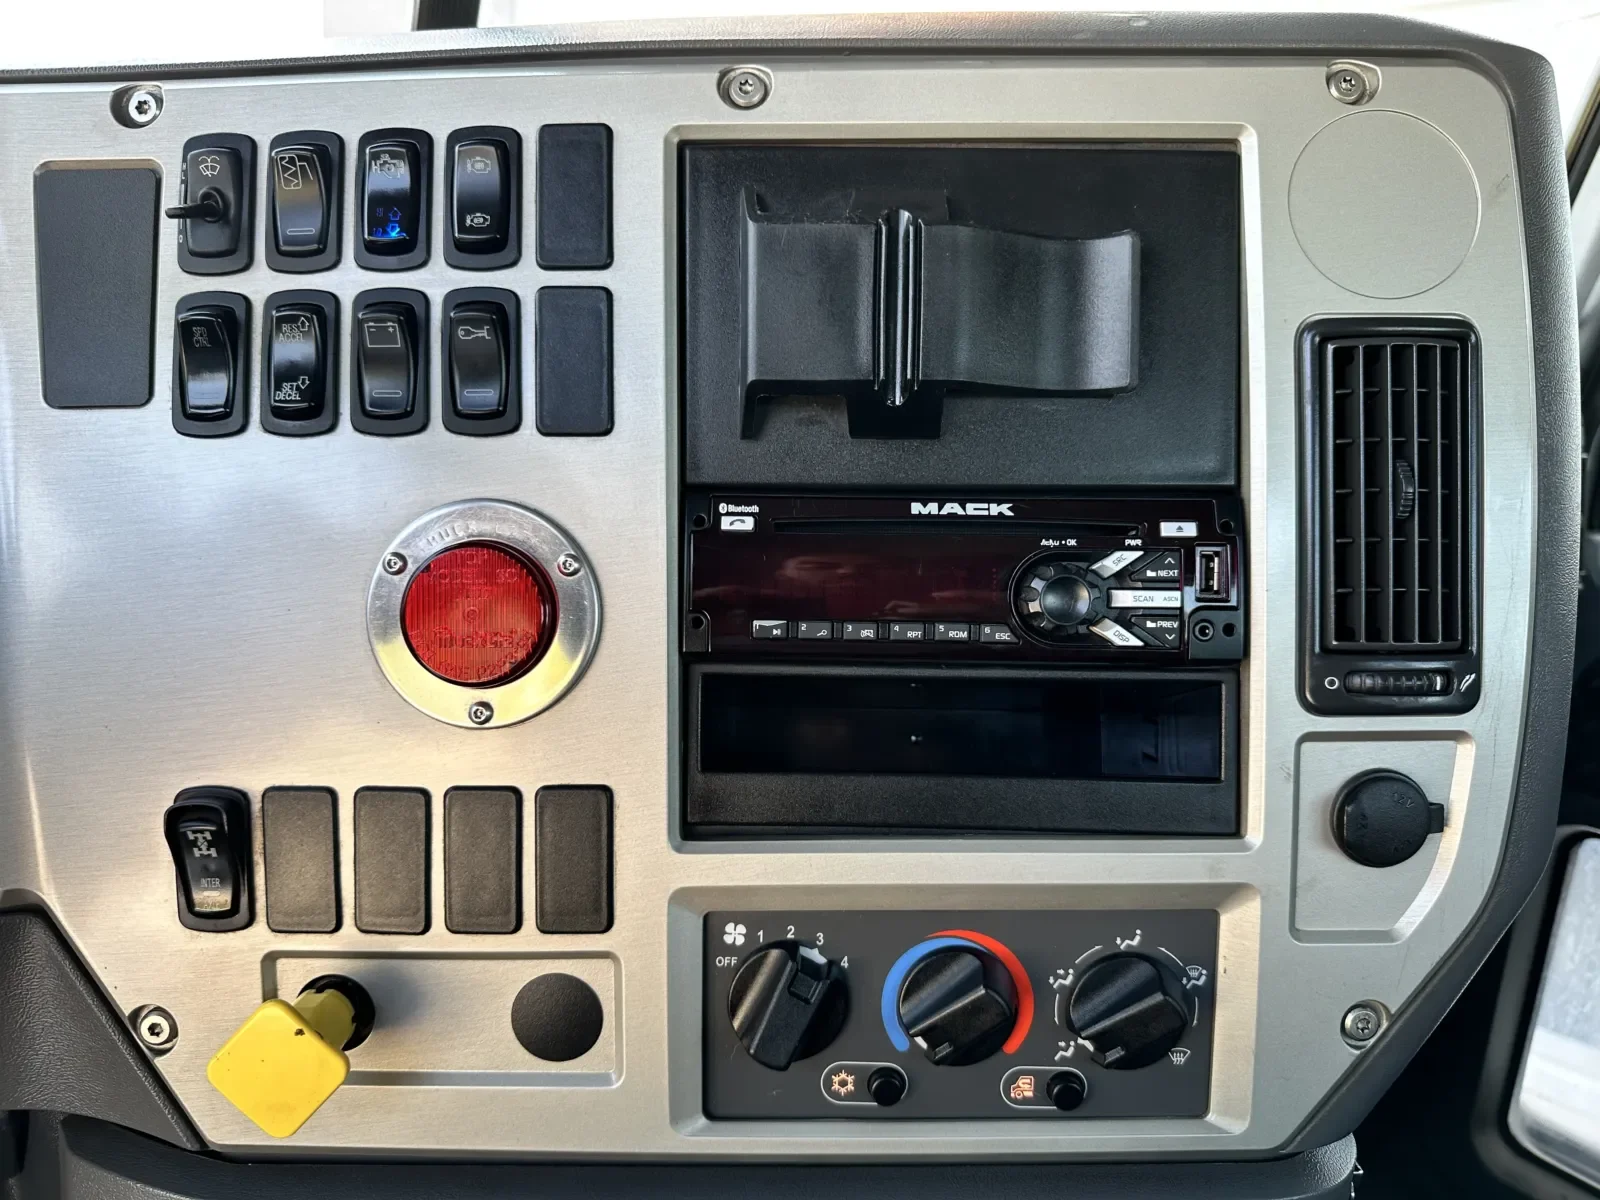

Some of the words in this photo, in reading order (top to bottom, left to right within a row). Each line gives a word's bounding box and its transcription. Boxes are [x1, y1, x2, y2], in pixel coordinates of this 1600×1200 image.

[282, 382, 298, 393] SET
[275, 391, 301, 401] DECEL
[727, 504, 759, 513] Bluetooth
[910, 501, 1015, 516] MACK
[1066, 538, 1078, 547] OK
[1125, 538, 1142, 547] PWR
[1112, 553, 1128, 567] SRC
[1157, 569, 1179, 577] NEXT
[1133, 595, 1154, 603] SCAN
[801, 623, 807, 631] 2
[846, 624, 853, 632] 3
[938, 624, 945, 632] 5
[984, 626, 991, 634] 6
[906, 631, 922, 639] RPT
[948, 631, 968, 639] RDM
[1112, 629, 1130, 643] DISP
[200, 877, 220, 888] INTER
[757, 929, 764, 943] 1
[786, 925, 795, 939] 2
[815, 932, 824, 946] 3
[715, 956, 738, 967] OFF
[840, 955, 849, 969] 4
